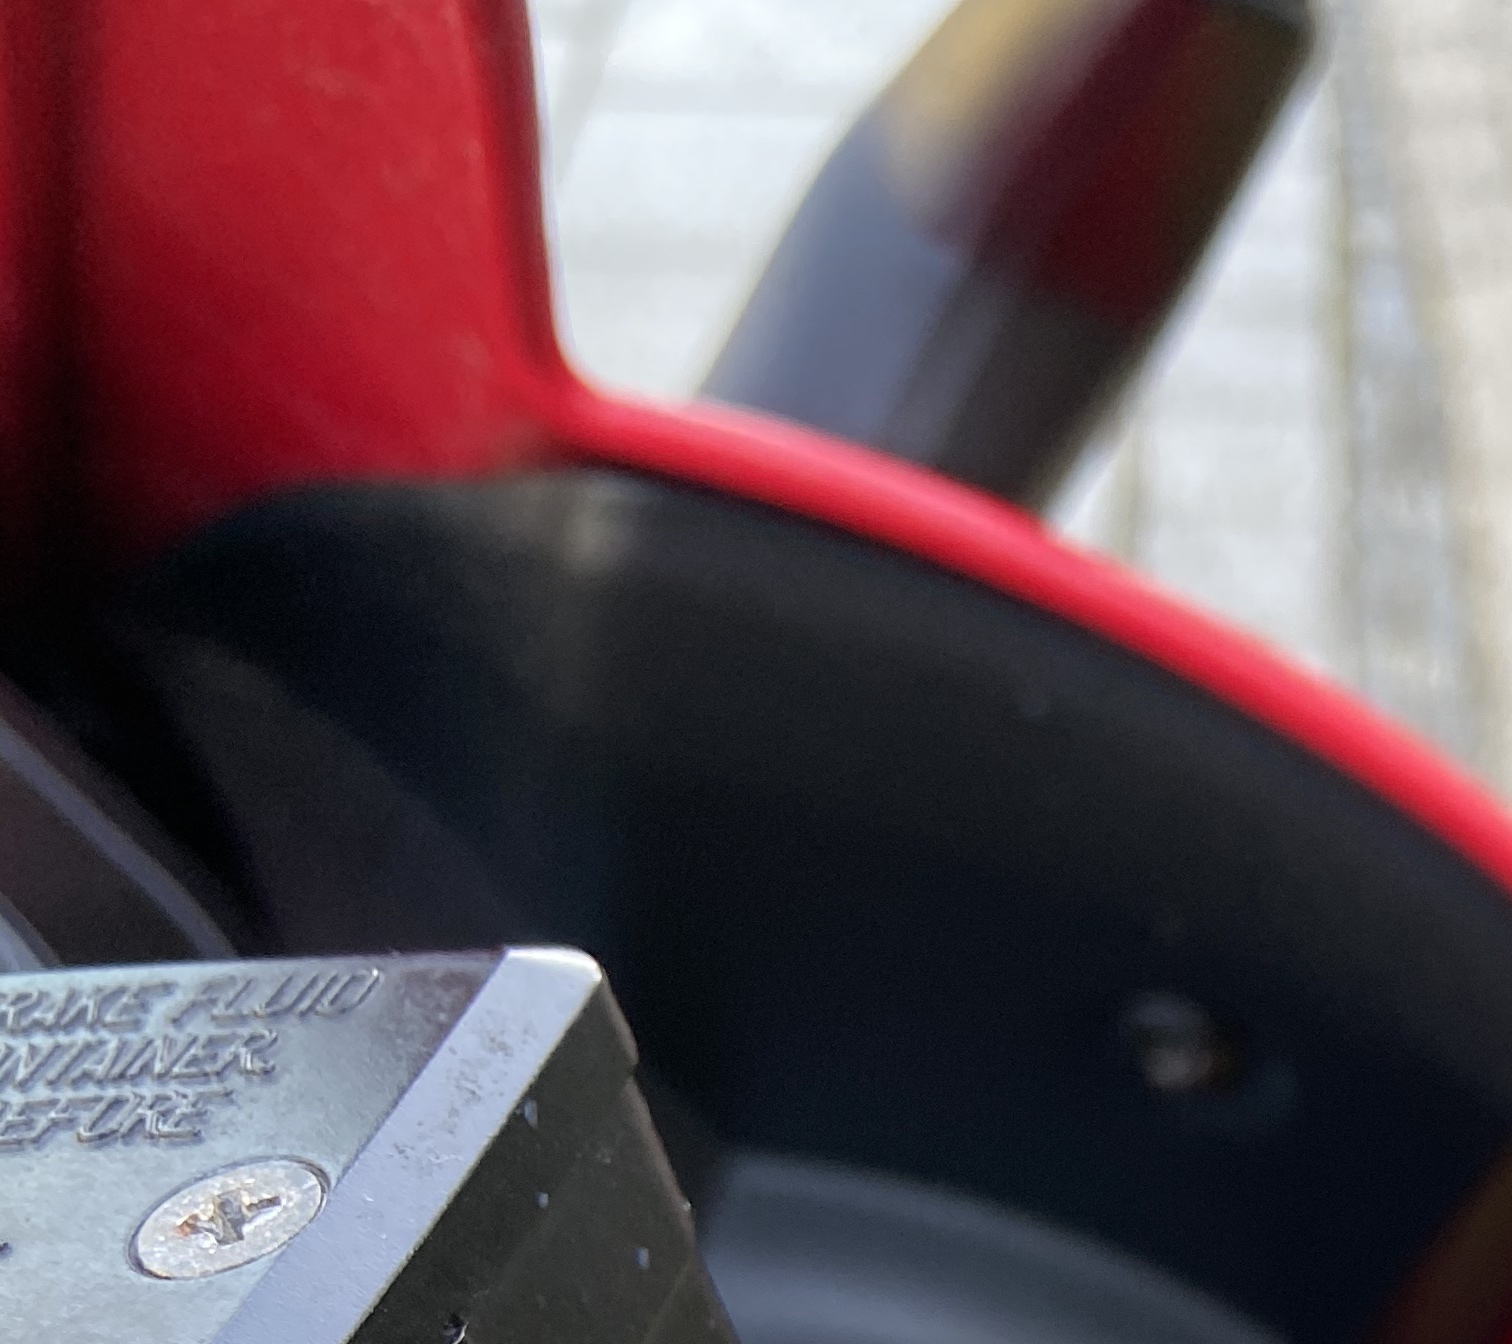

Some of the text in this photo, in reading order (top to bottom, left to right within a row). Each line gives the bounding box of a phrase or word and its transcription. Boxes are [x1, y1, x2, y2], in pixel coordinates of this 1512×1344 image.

[0, 967, 384, 1034] RAKE FLUID
[0, 1028, 280, 1088] NTAINER
[0, 1088, 235, 1145] EFORE
